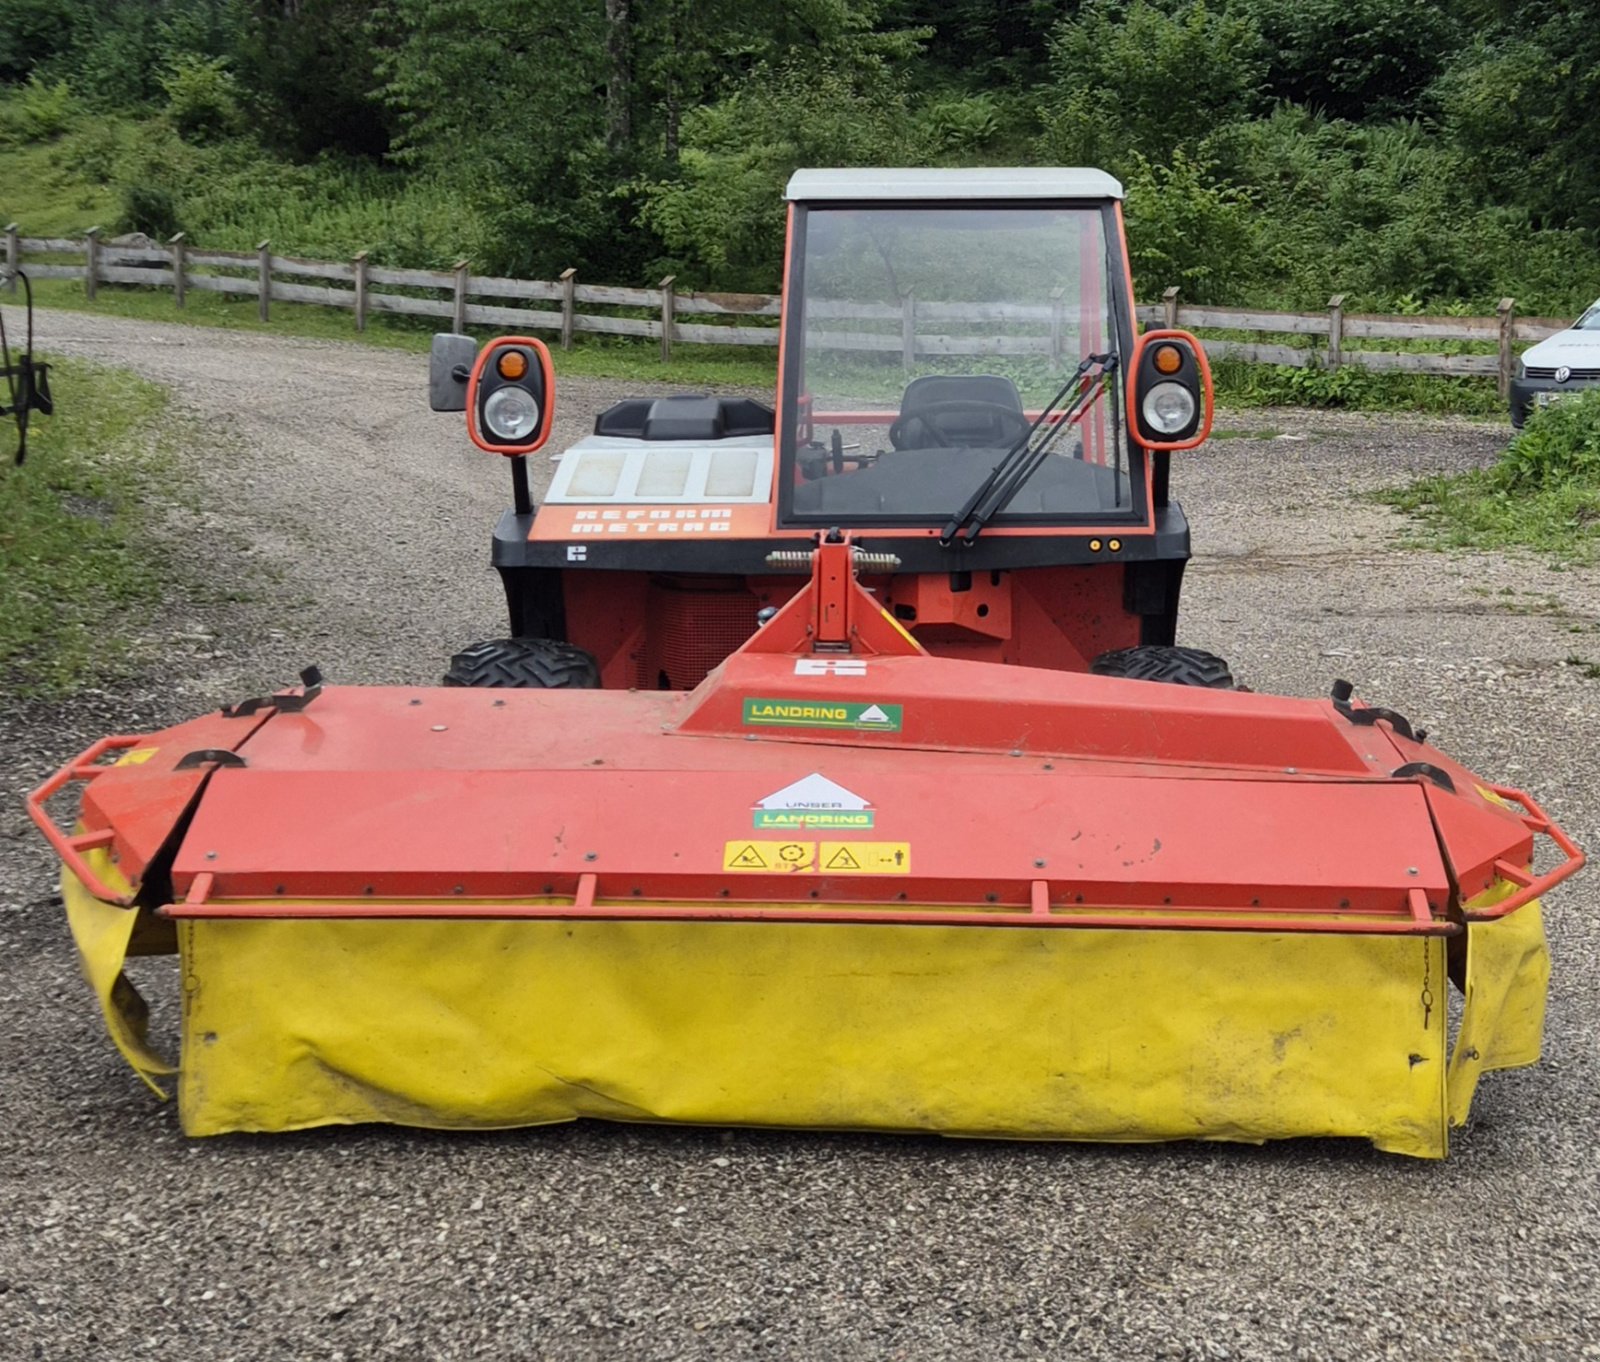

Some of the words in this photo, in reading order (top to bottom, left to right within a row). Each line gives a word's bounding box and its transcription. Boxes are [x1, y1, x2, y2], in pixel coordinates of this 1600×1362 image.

[575, 509, 732, 520] REFORM
[571, 522, 731, 533] METRAC
[751, 705, 848, 720] LANDRING
[763, 814, 869, 824] LANDRING
